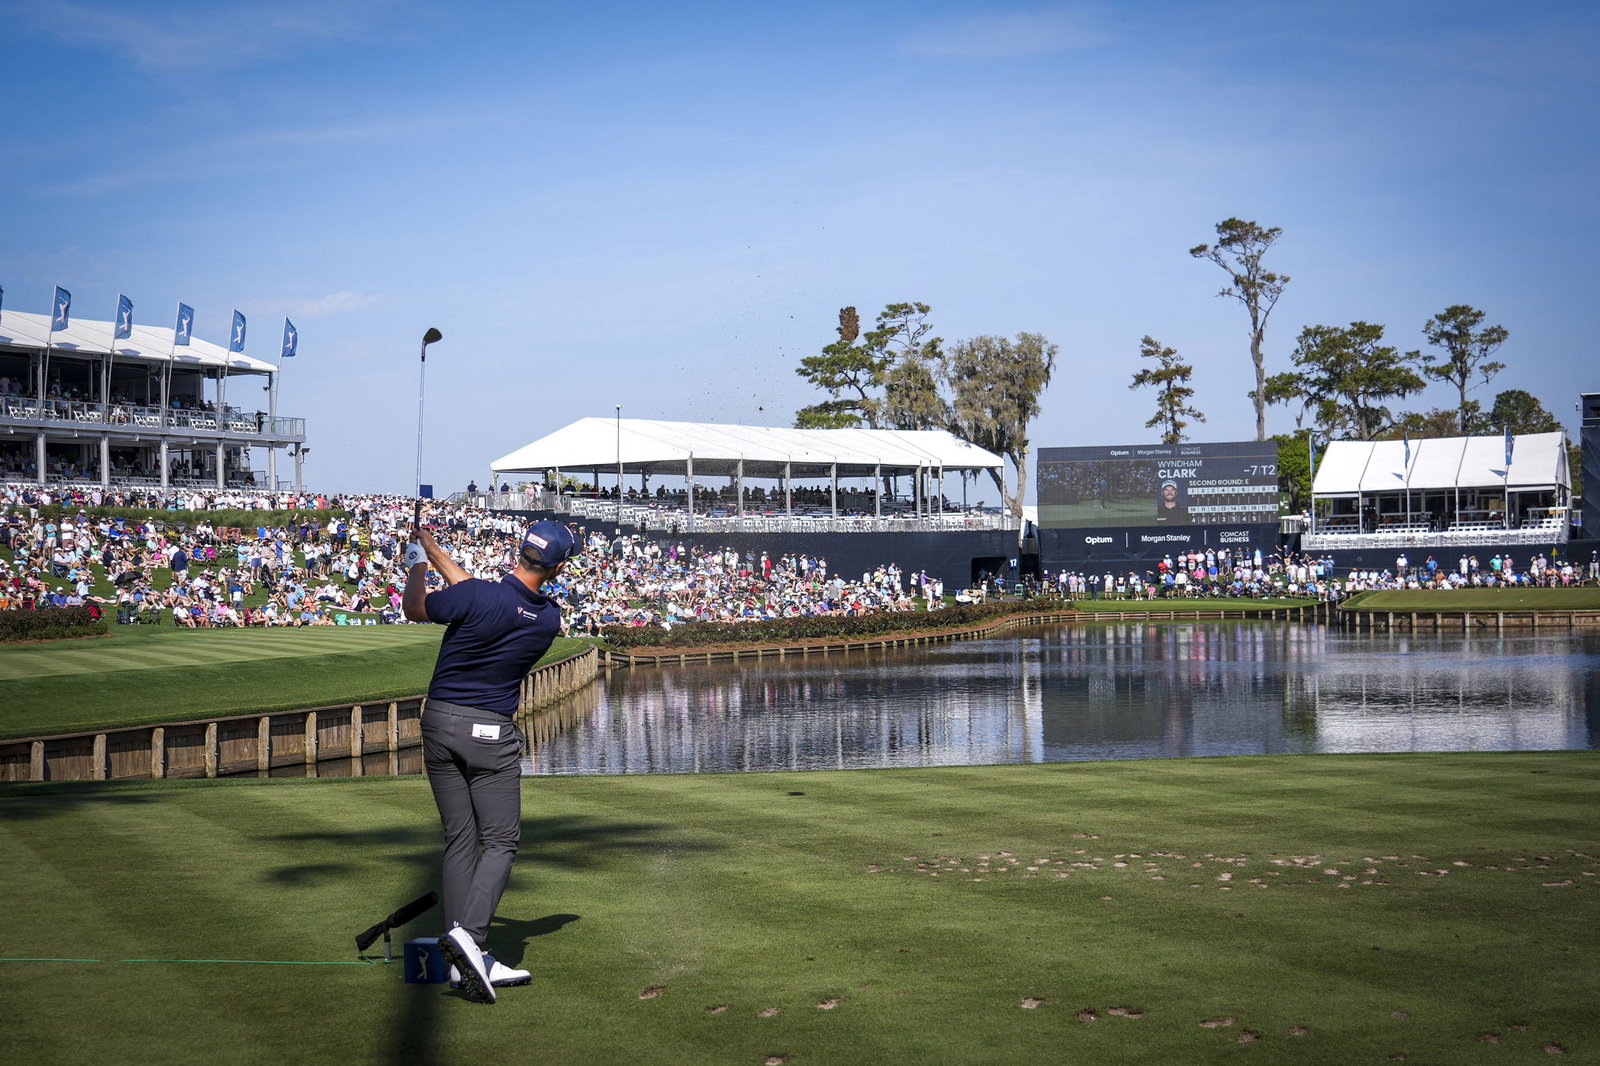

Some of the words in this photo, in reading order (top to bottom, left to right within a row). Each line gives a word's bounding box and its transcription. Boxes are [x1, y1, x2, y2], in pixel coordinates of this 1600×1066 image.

[1158, 468, 1197, 478] CLARK
[1261, 464, 1276, 475] T2
[1085, 536, 1113, 545] Optum
[1141, 534, 1166, 543] Morgan
[1166, 534, 1191, 542] Stanley
[1010, 559, 1017, 567] 17
